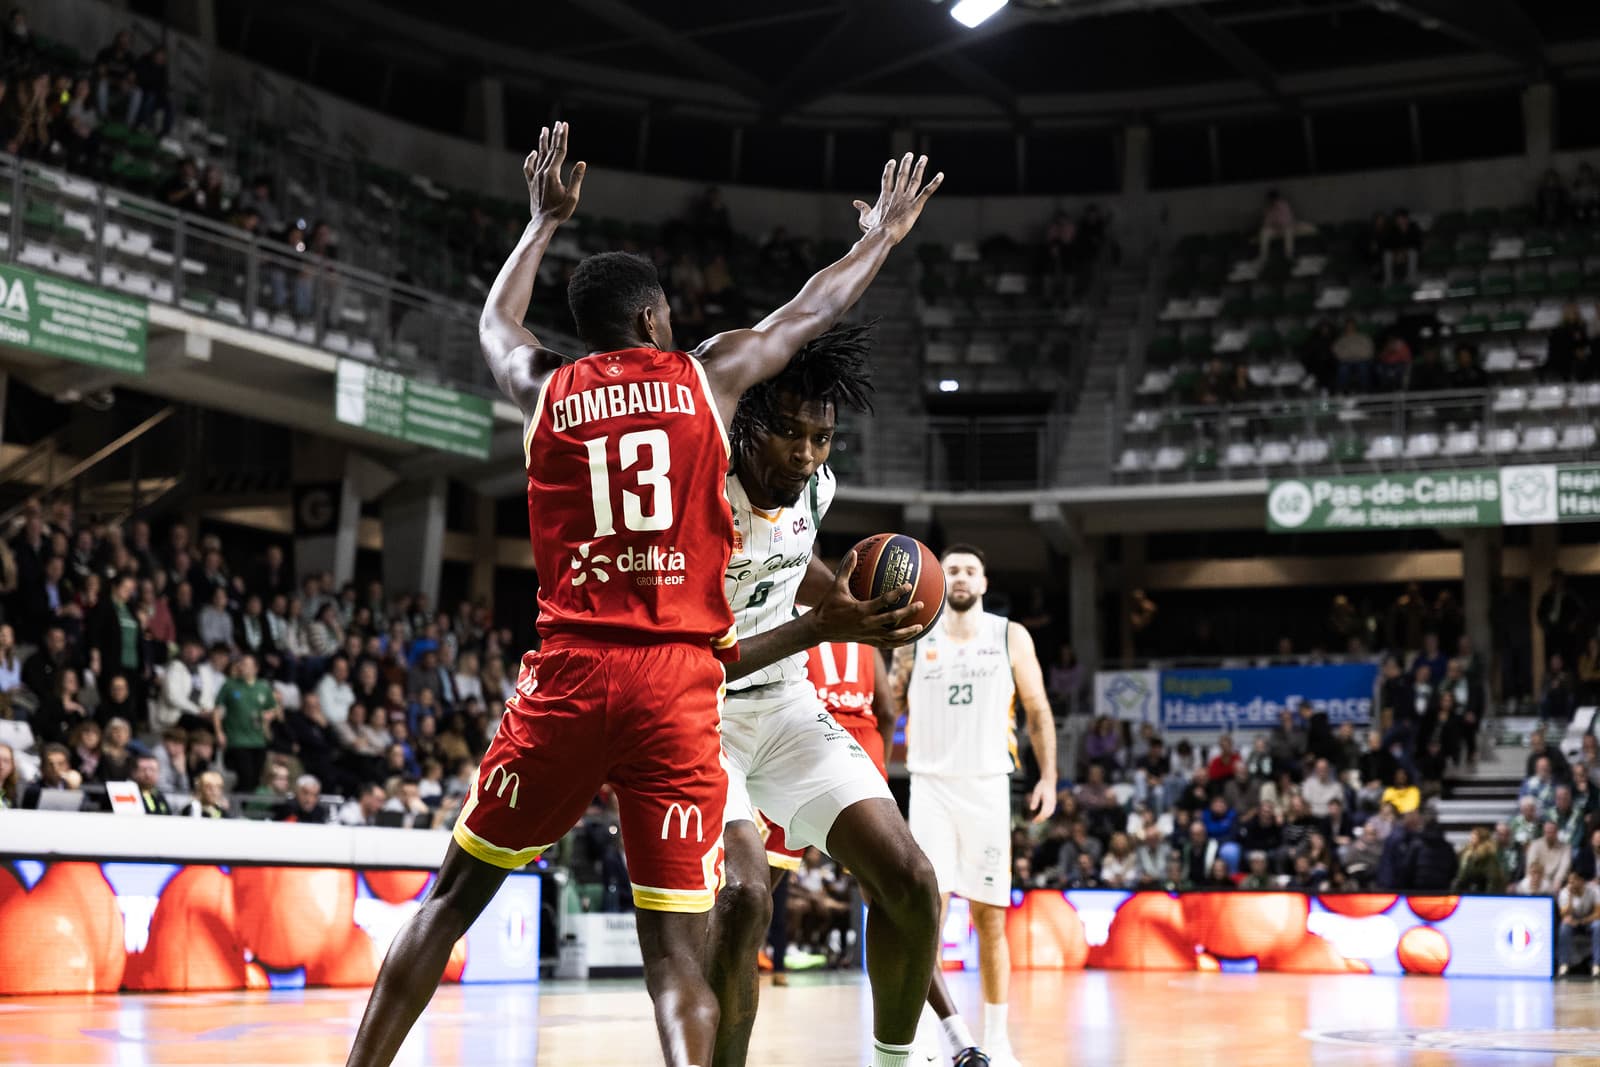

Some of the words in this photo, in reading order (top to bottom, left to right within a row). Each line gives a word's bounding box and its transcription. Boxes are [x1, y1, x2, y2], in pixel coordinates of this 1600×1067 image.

[552, 382, 695, 432] GOMBAULD
[583, 429, 673, 537] 13
[1313, 475, 1498, 507] Pas-de-Calais
[616, 545, 685, 572] dalkia
[948, 684, 974, 705] 23
[1165, 694, 1372, 723] Hauts-de-Fance
